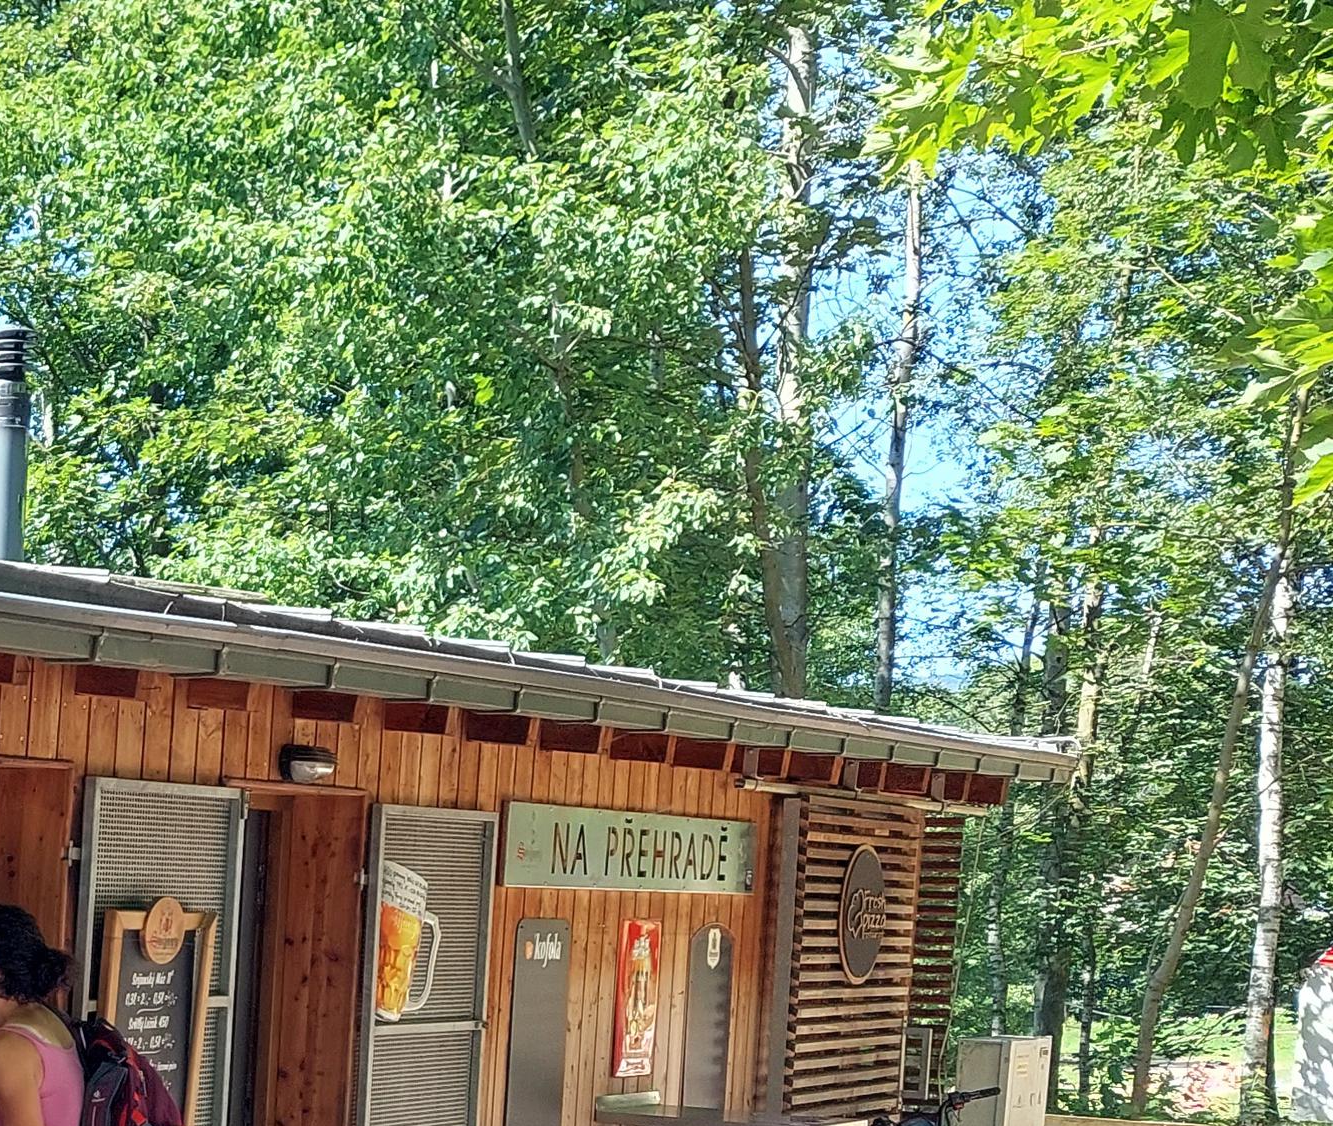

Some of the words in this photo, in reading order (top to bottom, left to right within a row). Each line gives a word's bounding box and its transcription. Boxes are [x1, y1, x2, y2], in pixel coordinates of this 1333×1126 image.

[551, 822, 588, 876] NA
[604, 818, 729, 882] PŘEHRADĚ
[864, 889, 885, 912] Fresh
[533, 931, 562, 968] kofola
